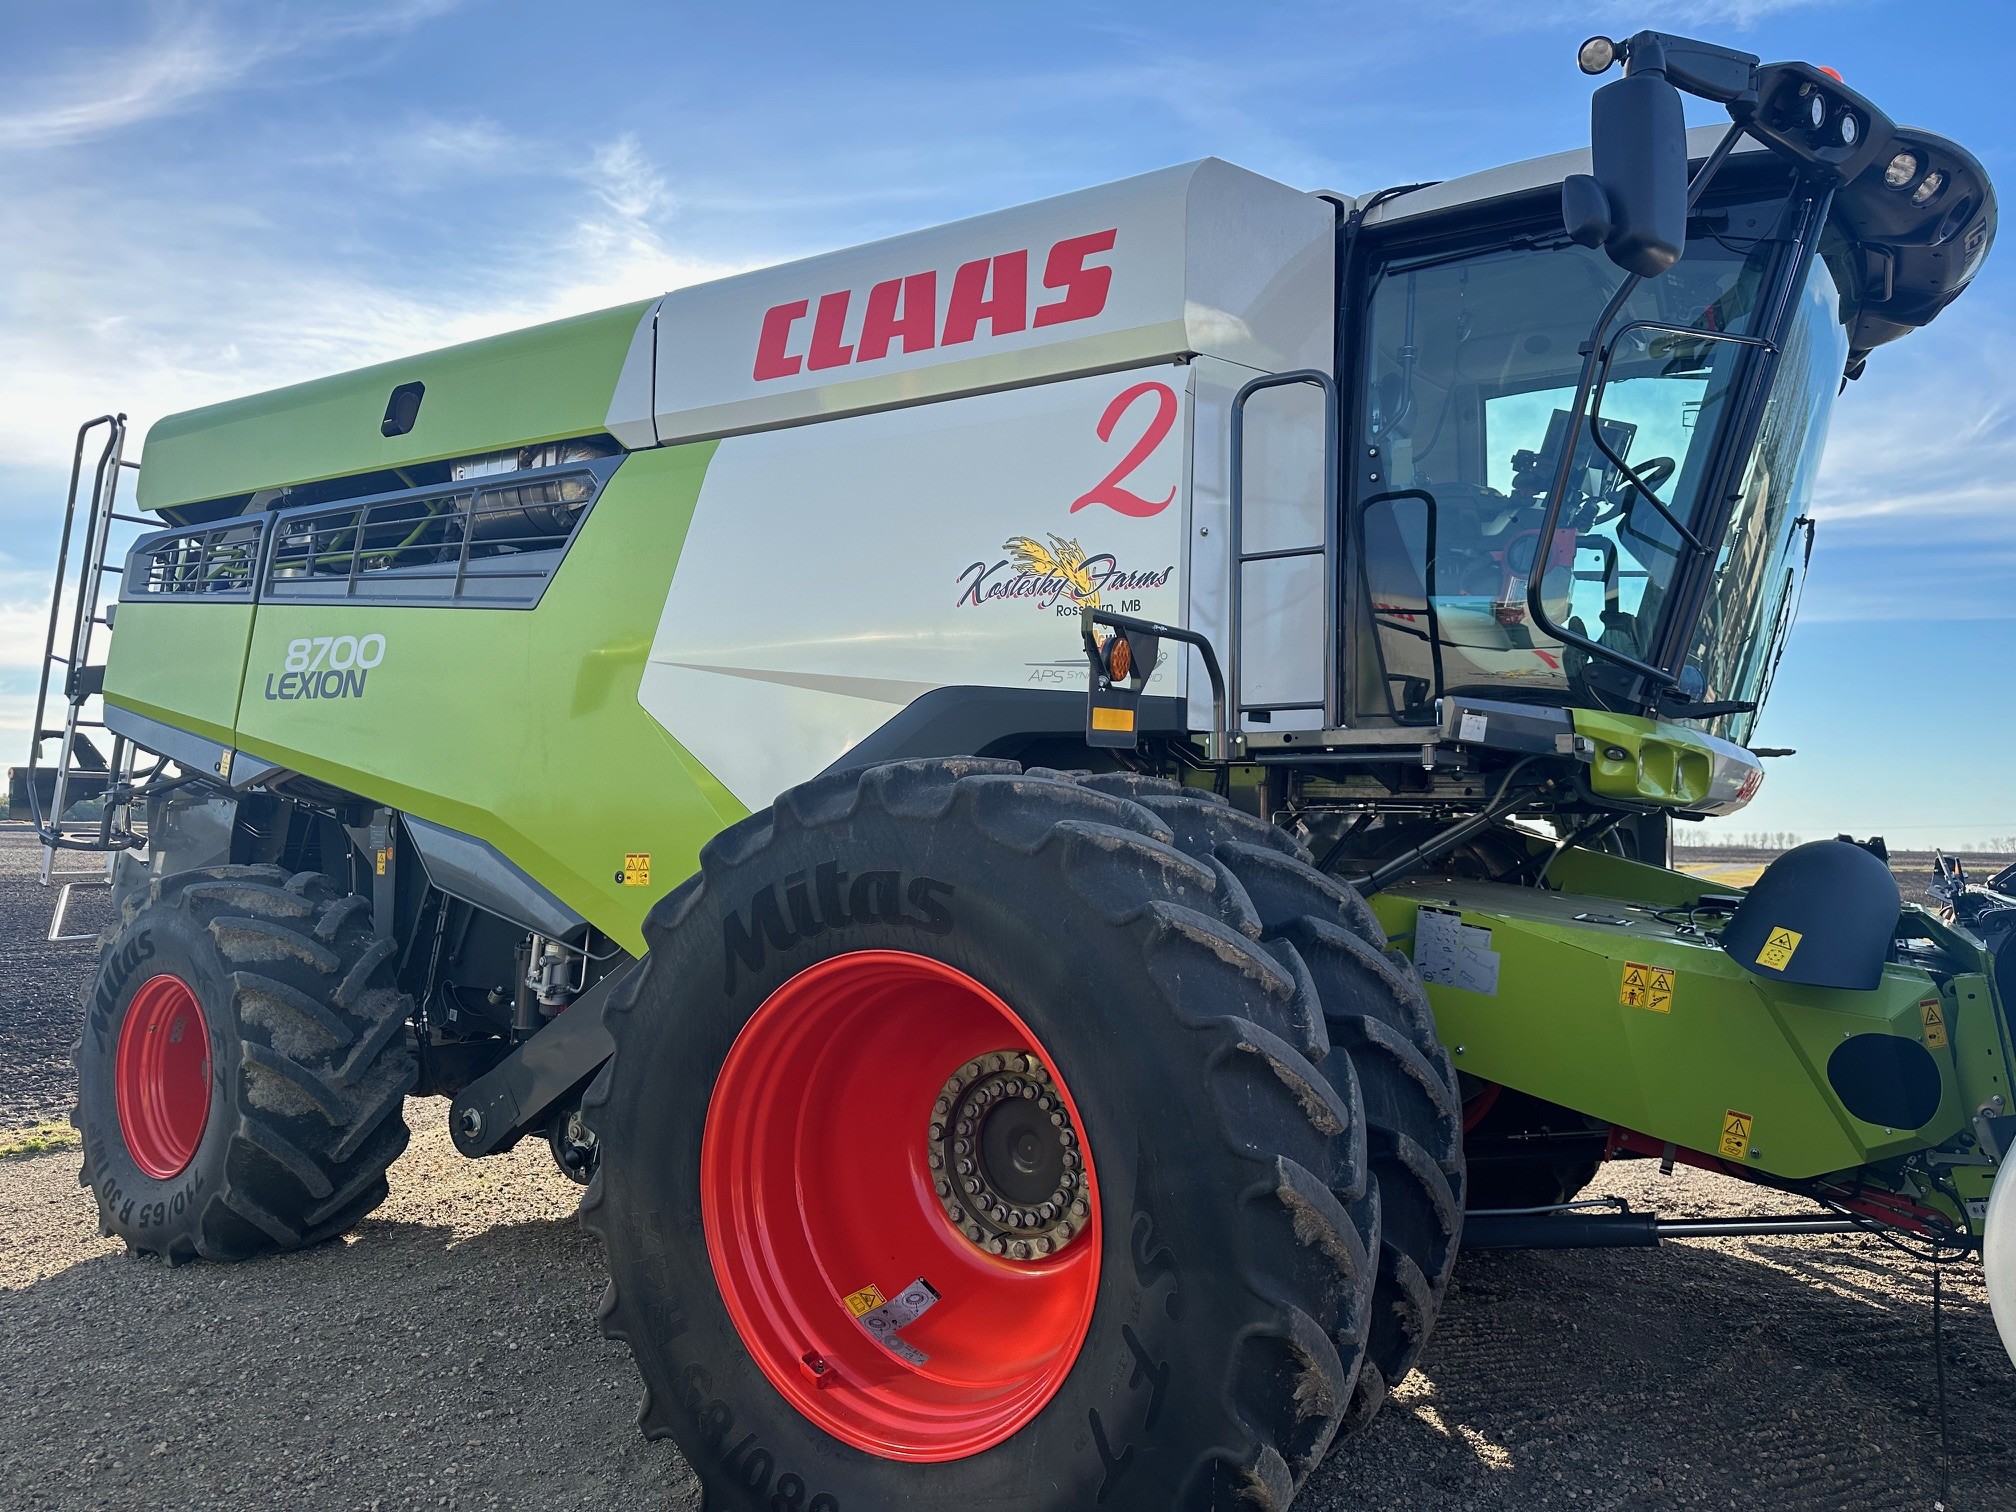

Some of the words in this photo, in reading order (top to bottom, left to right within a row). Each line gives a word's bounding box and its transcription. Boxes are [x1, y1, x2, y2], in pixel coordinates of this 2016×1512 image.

[752, 228, 1119, 382] CLAAS
[1069, 381, 1178, 517] 2
[955, 559, 1069, 610] Kostesky
[1069, 553, 1175, 603] Farms
[1121, 599, 1141, 612] MB
[284, 633, 387, 673] 8700
[1028, 669, 1066, 683] APS
[264, 669, 368, 700] LEXION
[722, 859, 956, 999] Mitas
[90, 928, 156, 1053] Mitas
[138, 1166, 205, 1229] 710/65
